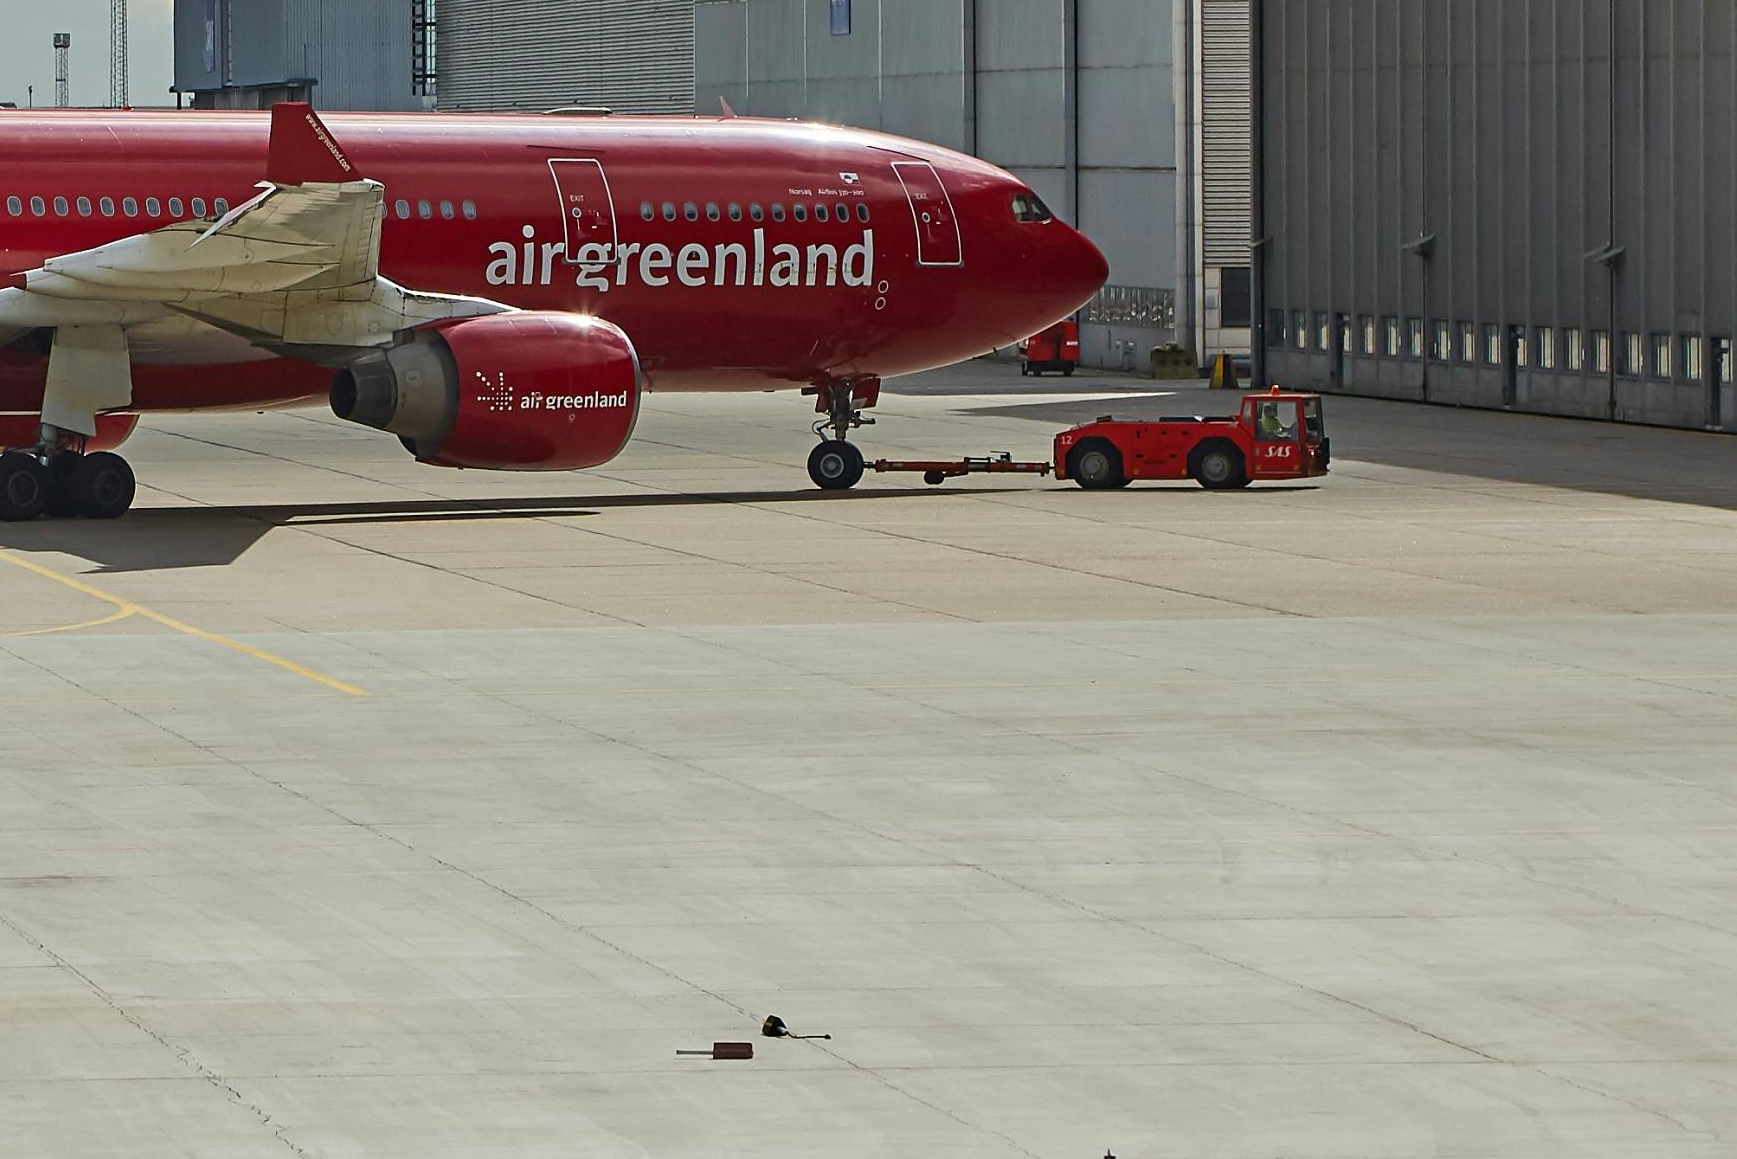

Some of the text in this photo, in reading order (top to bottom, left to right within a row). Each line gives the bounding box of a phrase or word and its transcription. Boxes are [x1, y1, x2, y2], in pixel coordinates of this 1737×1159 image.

[485, 224, 874, 293] air greenland
[520, 390, 628, 410] air greenland
[1061, 435, 1073, 445] 12
[1265, 445, 1292, 458] SAS
